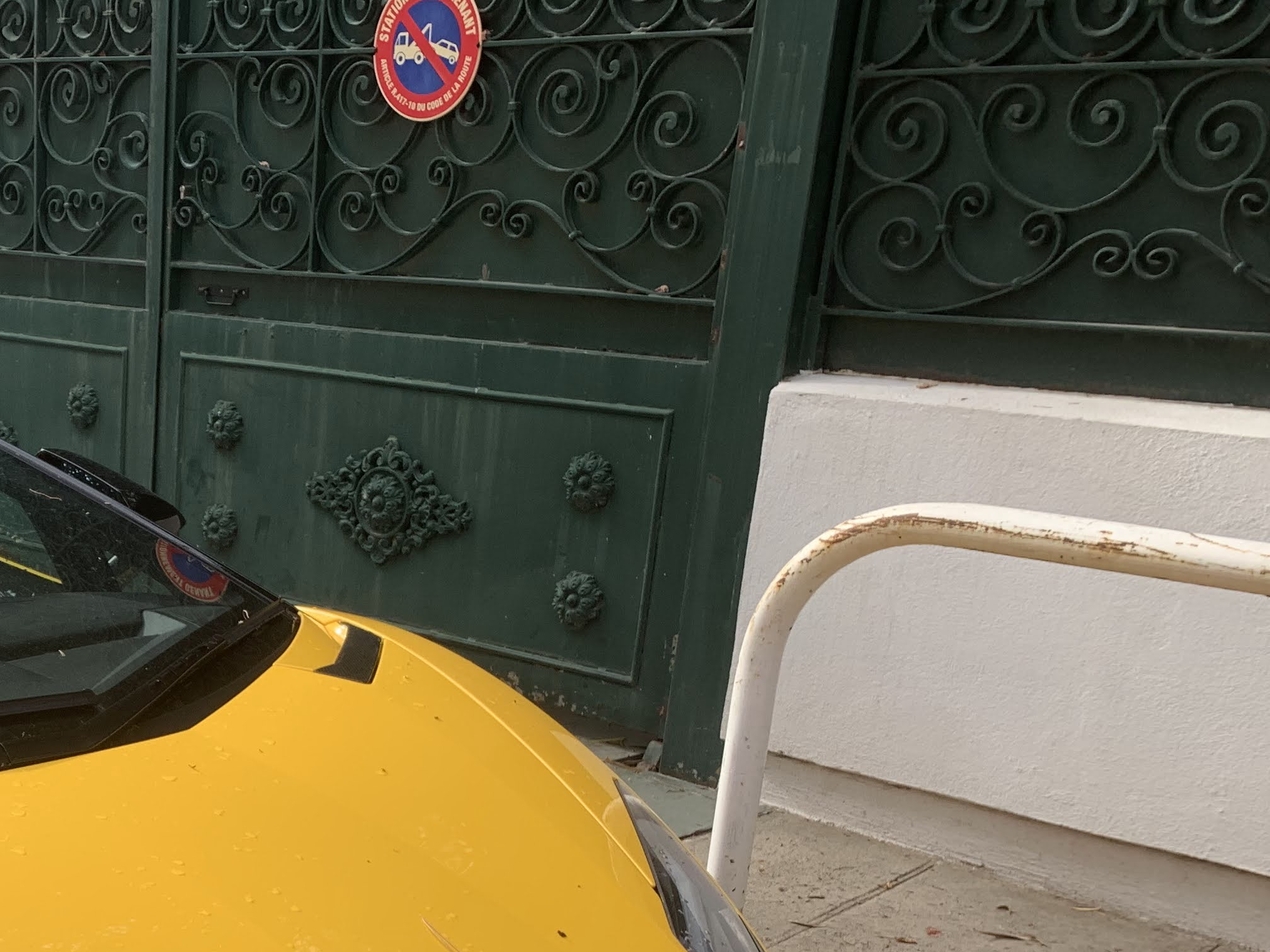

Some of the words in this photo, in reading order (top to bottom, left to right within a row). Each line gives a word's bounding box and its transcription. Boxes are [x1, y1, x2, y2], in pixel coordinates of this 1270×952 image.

[380, 58, 394, 90] ARTICLE
[416, 102, 426, 111] DU
[426, 97, 444, 111] CODE
[443, 90, 454, 103] DE
[450, 82, 461, 94] LA
[458, 55, 472, 84] ROUTE
